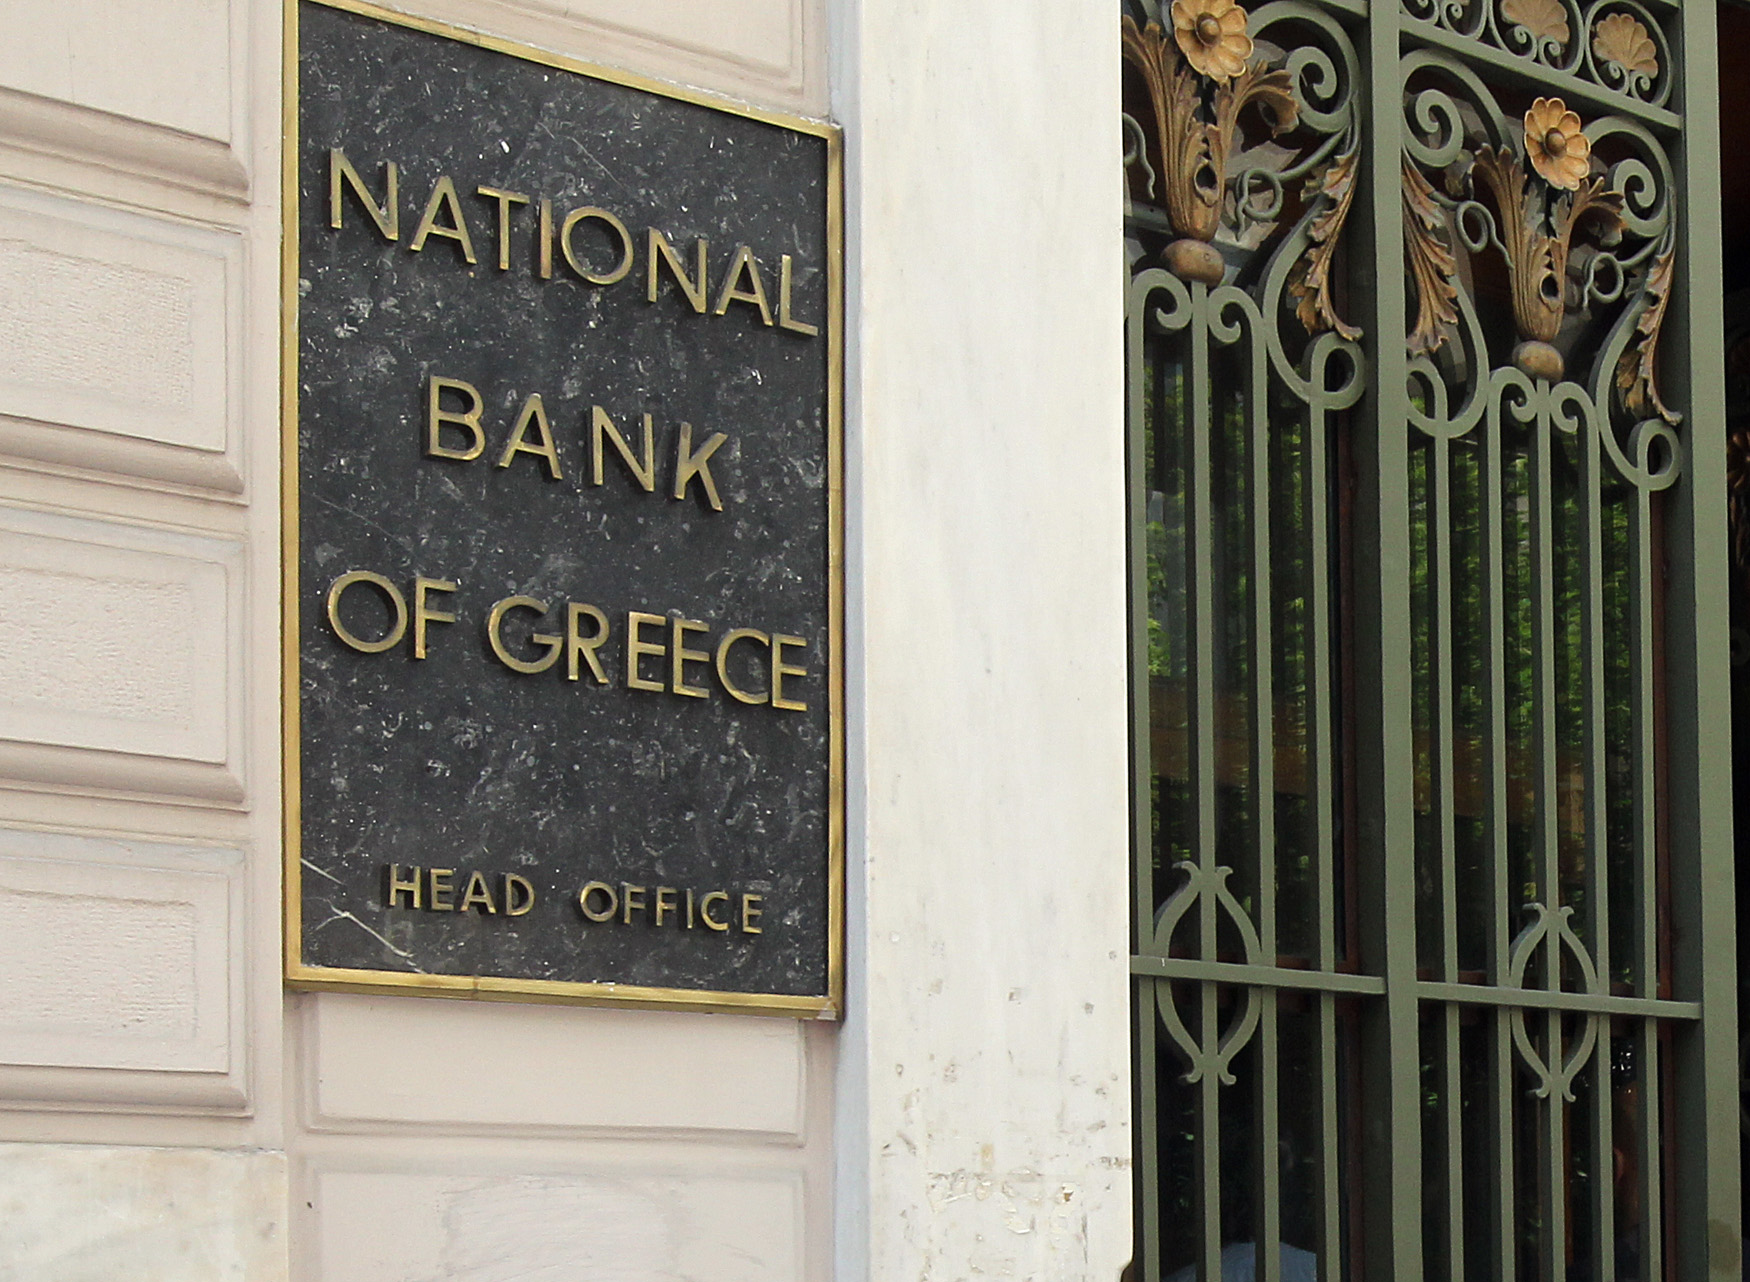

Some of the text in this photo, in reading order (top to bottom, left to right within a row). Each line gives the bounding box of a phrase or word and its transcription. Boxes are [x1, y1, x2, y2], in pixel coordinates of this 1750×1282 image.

[330, 148, 818, 337] NATIONAL
[425, 375, 728, 512] BANK
[327, 570, 808, 711] OF GREECE
[388, 863, 763, 934] HEAD OFFICE
